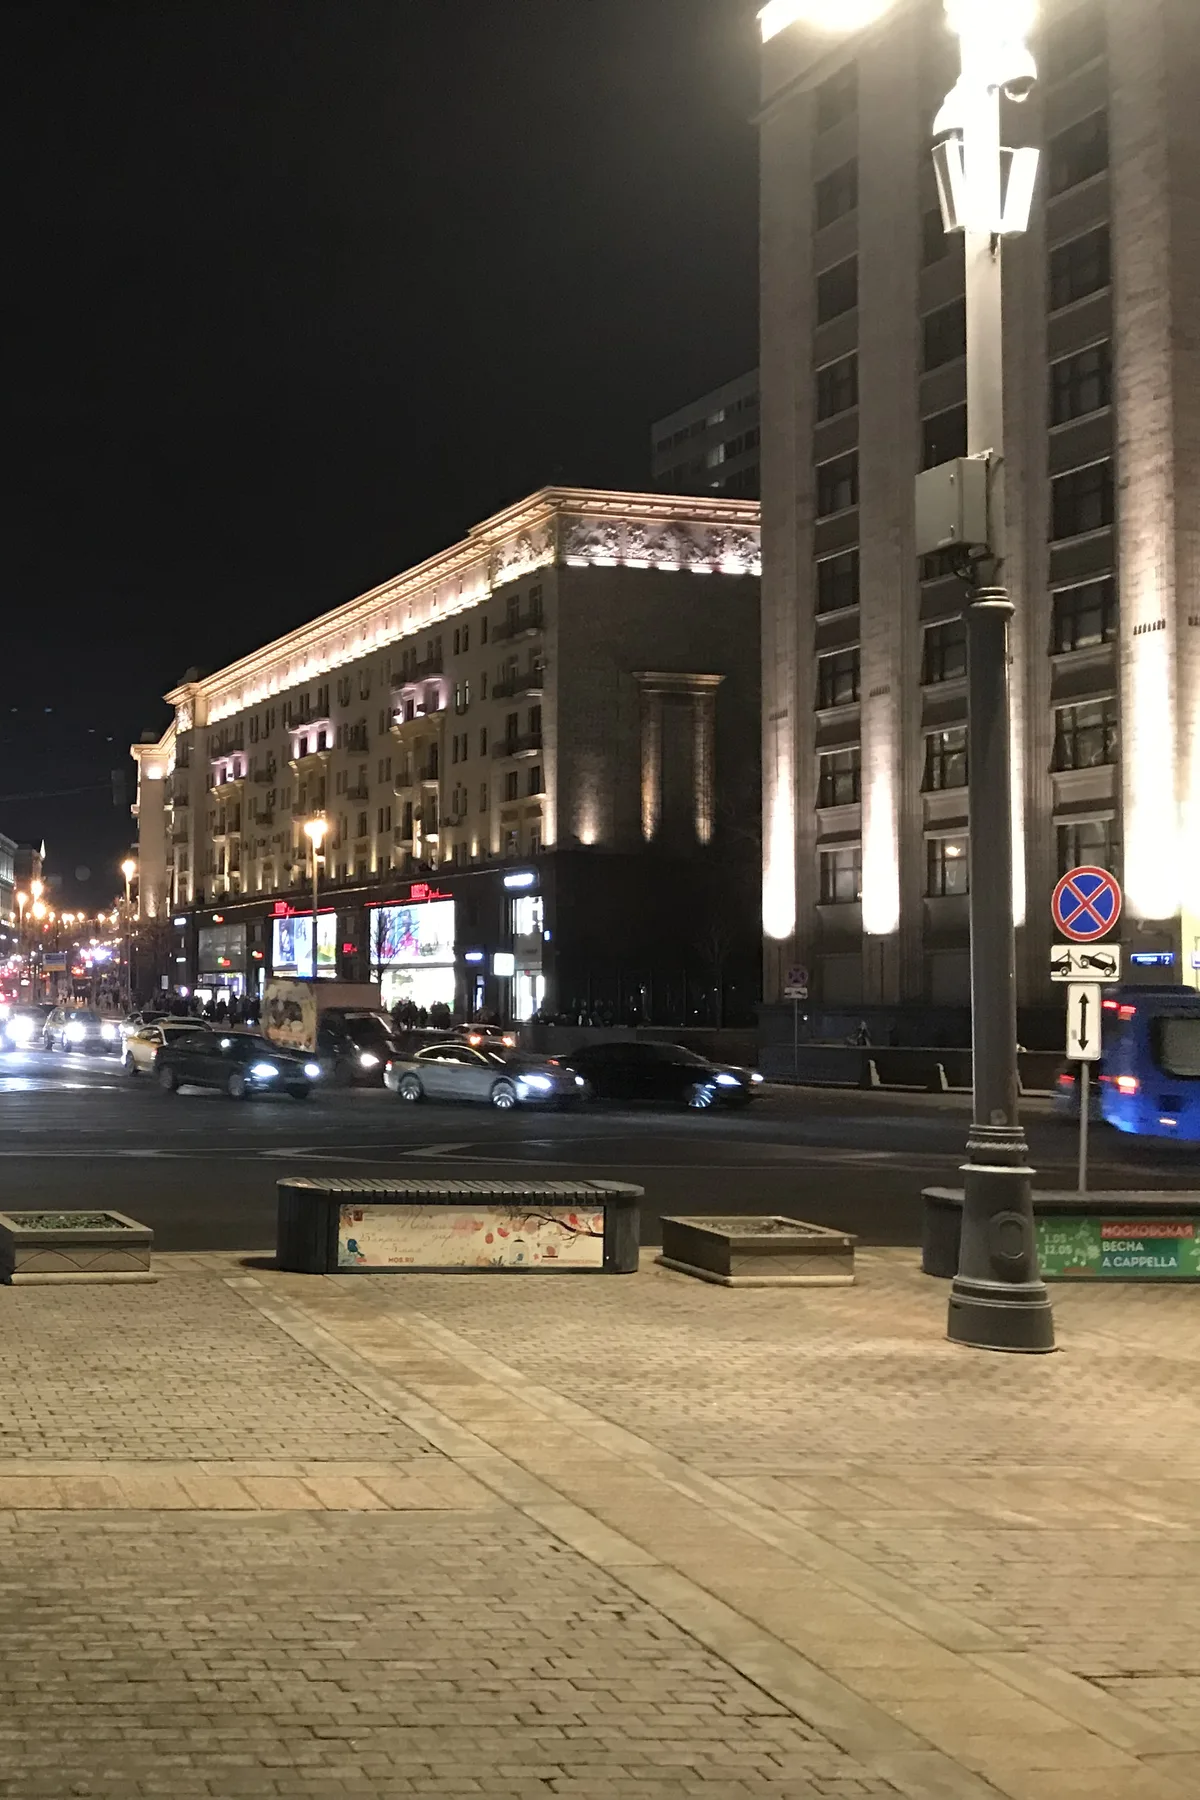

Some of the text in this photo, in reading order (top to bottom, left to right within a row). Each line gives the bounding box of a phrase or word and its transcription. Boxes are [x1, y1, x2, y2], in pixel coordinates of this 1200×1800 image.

[1101, 1224, 1193, 1237] МОСКОВСКАЯ
[1102, 1240, 1145, 1252] ВЕСНА
[388, 1256, 415, 1264] MOS.RU
[1102, 1256, 1177, 1268] A CAPPELLA
